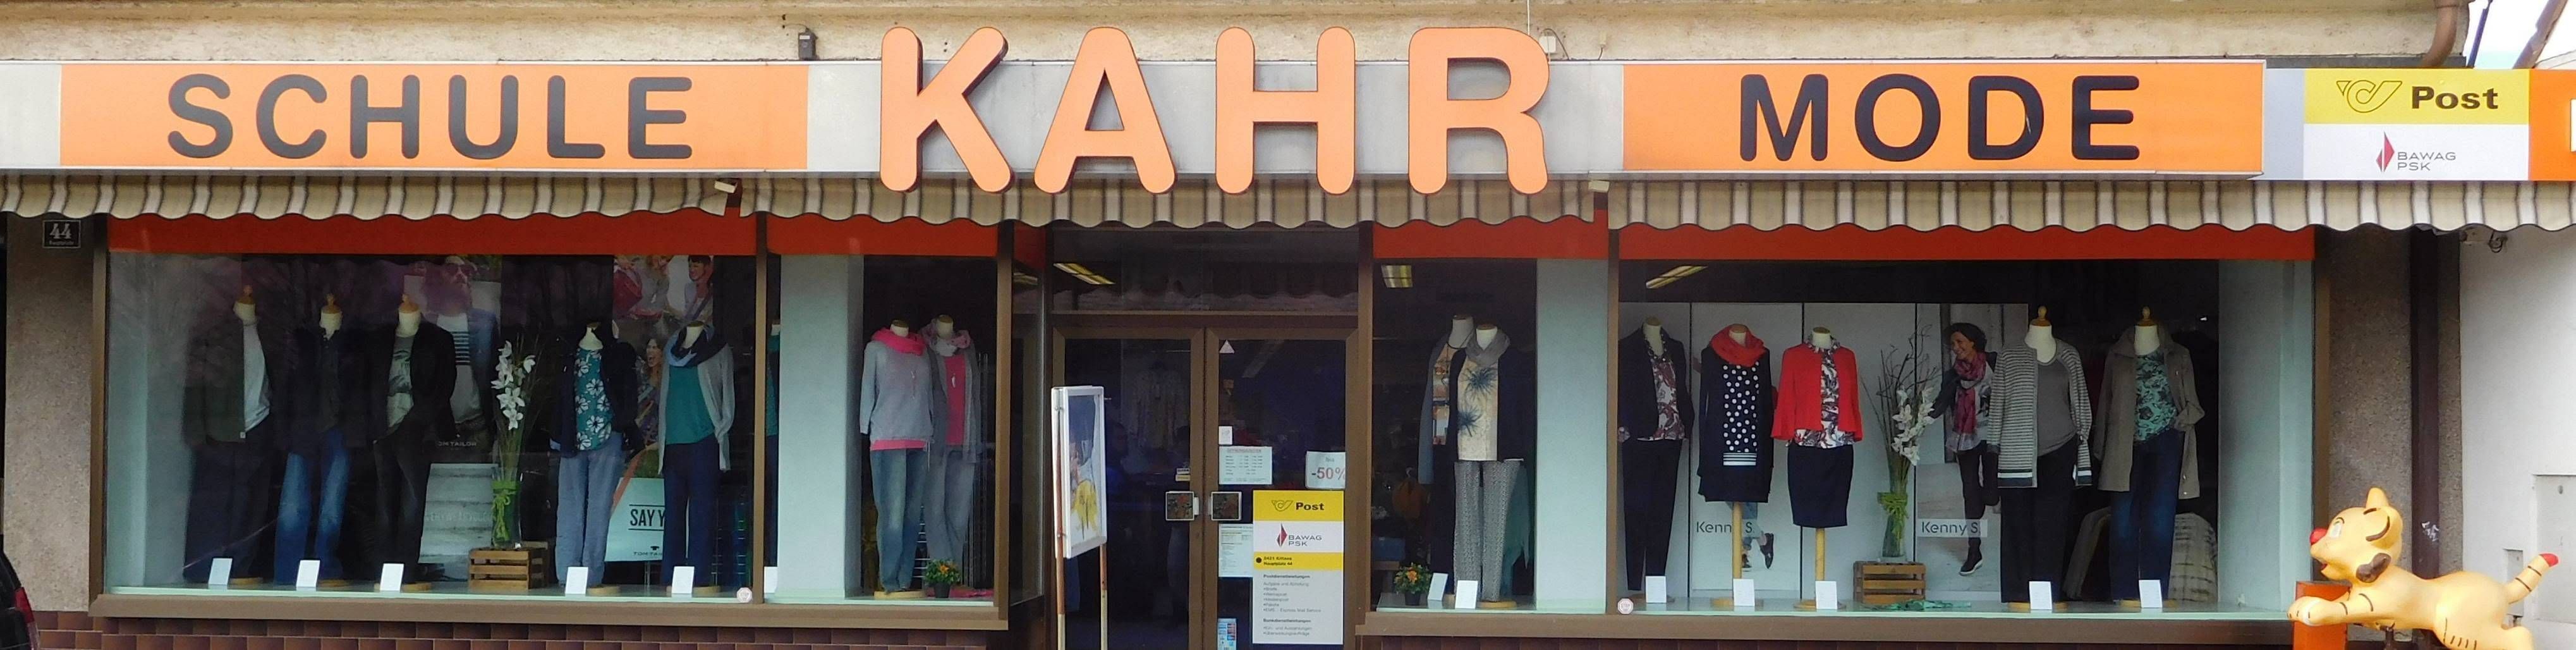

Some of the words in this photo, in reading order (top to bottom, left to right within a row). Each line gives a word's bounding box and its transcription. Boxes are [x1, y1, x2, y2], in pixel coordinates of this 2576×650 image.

[2412, 86, 2498, 109] Post
[168, 74, 693, 159] SCHULE
[880, 27, 1550, 195] KAHR
[1740, 73, 2141, 162] MODE
[2397, 152, 2456, 161] BAWAG
[2397, 162, 2431, 171] PSK
[49, 223, 72, 239] 44
[1311, 467, 1345, 480] -50%
[1296, 502, 1325, 510] Post
[630, 509, 655, 526] SAY
[1696, 522, 1732, 532] Kenn
[1922, 521, 1967, 536] Kenny
